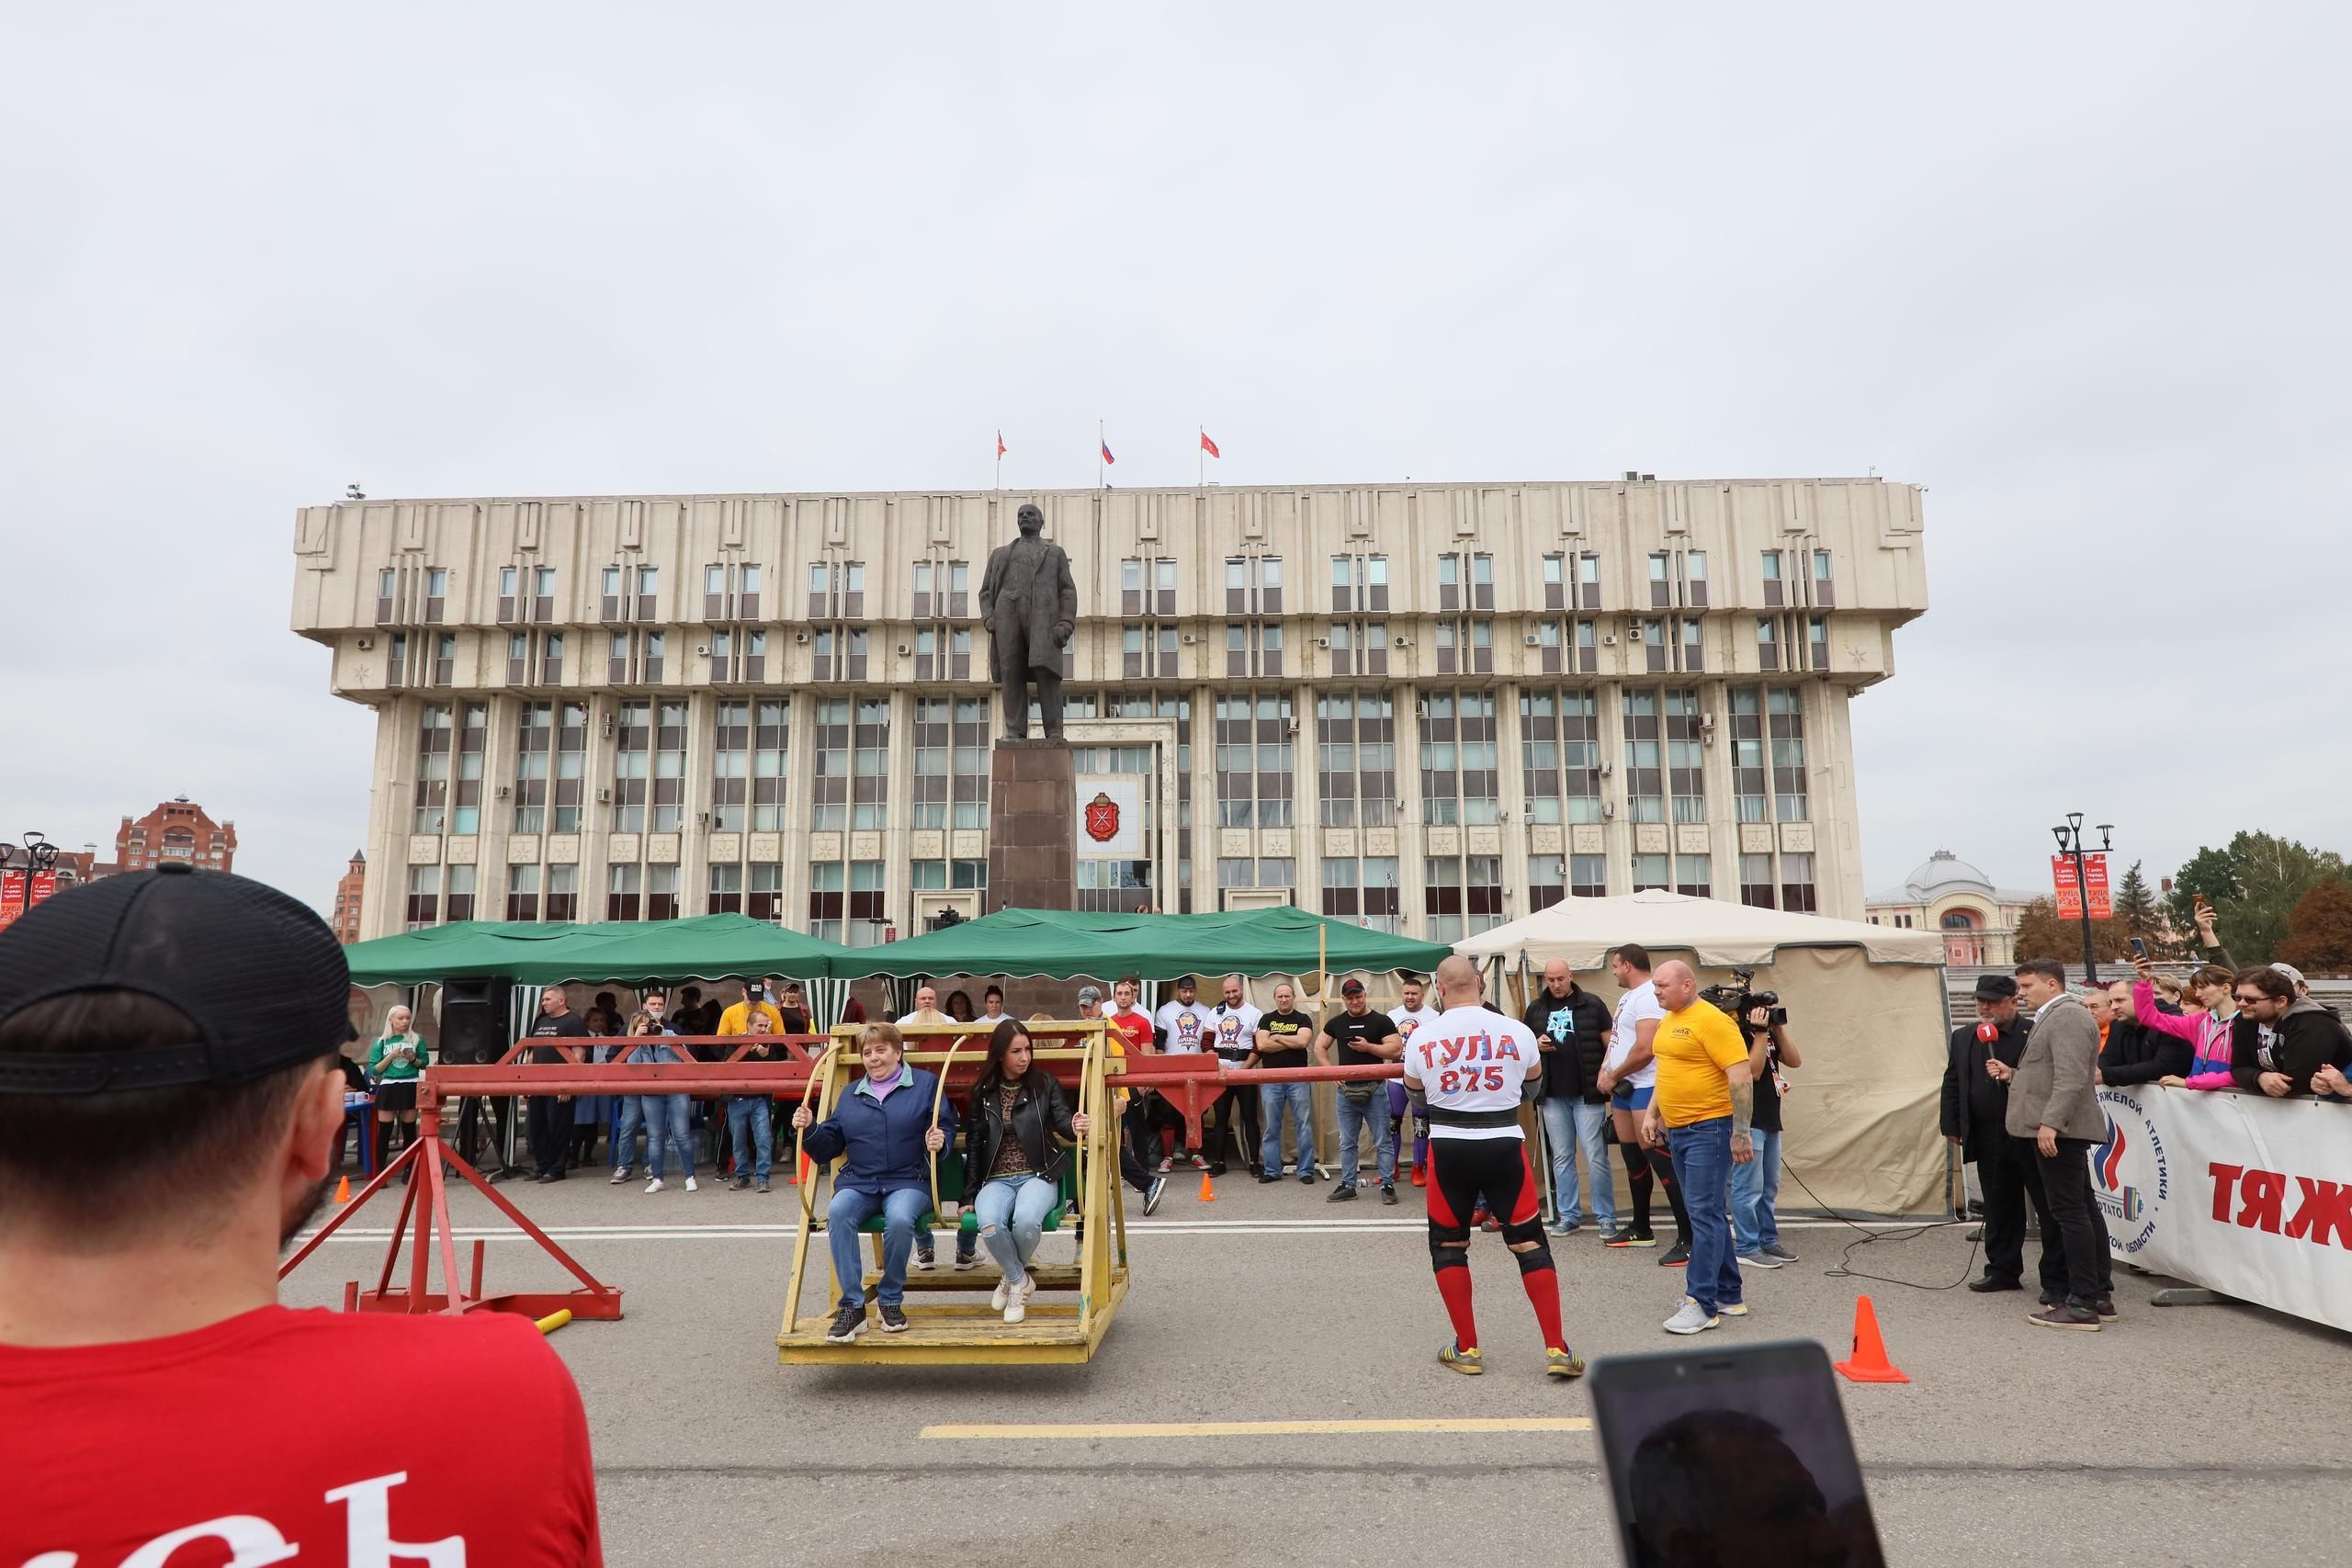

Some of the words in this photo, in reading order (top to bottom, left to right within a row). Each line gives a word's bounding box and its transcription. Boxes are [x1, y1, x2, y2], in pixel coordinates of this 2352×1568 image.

[1419, 1029, 1521, 1070] ТУЛА
[1440, 1065, 1504, 1095] 875
[2144, 1119, 2168, 1201] АТЛЕТИКИ
[2125, 1221, 2156, 1253] ОБЛАСТИ
